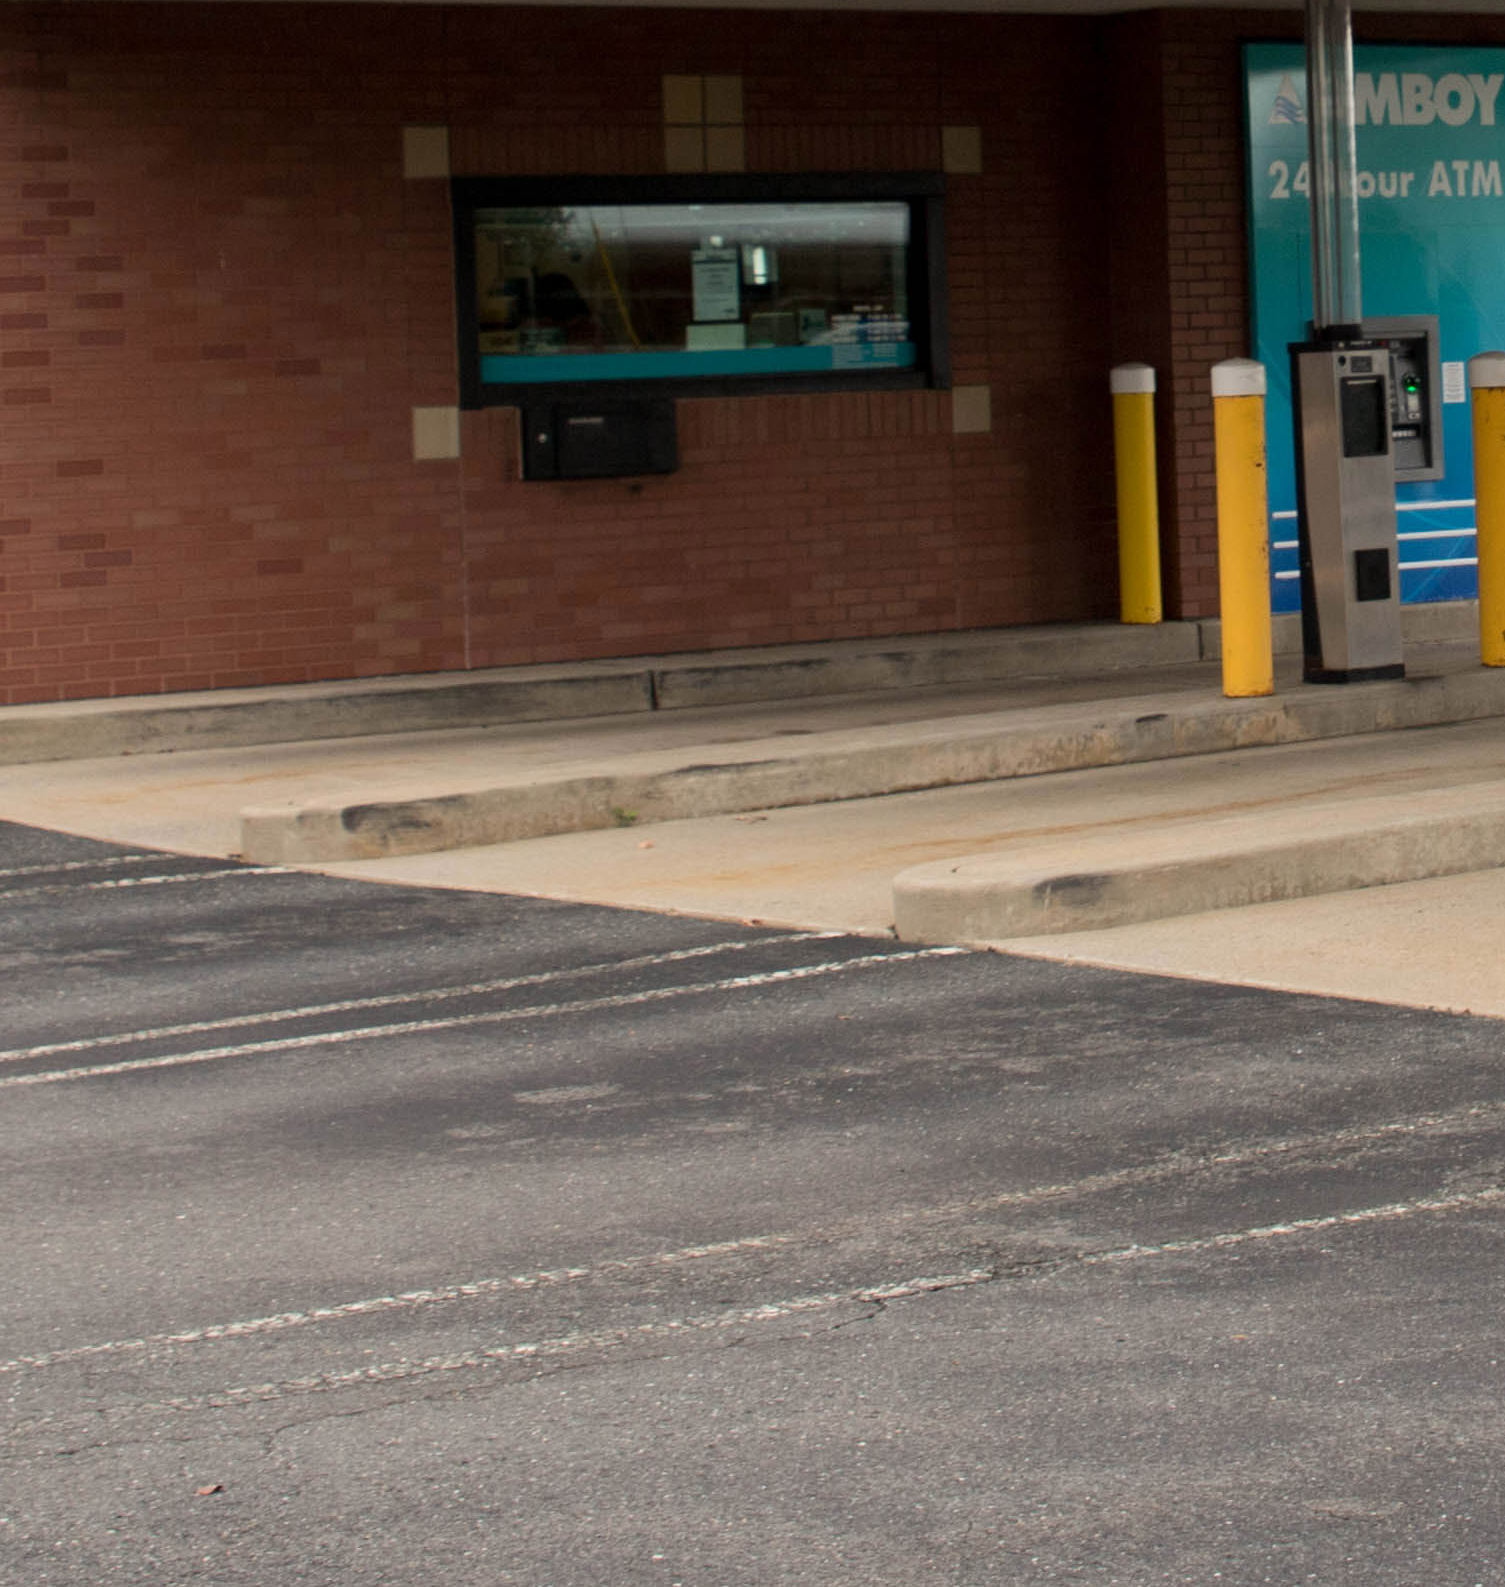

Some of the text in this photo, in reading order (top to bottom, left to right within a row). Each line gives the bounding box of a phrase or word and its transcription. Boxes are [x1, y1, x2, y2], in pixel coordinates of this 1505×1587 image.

[1354, 73, 1504, 126] MBOY
[1268, 160, 1503, 199] 24 our ATM
